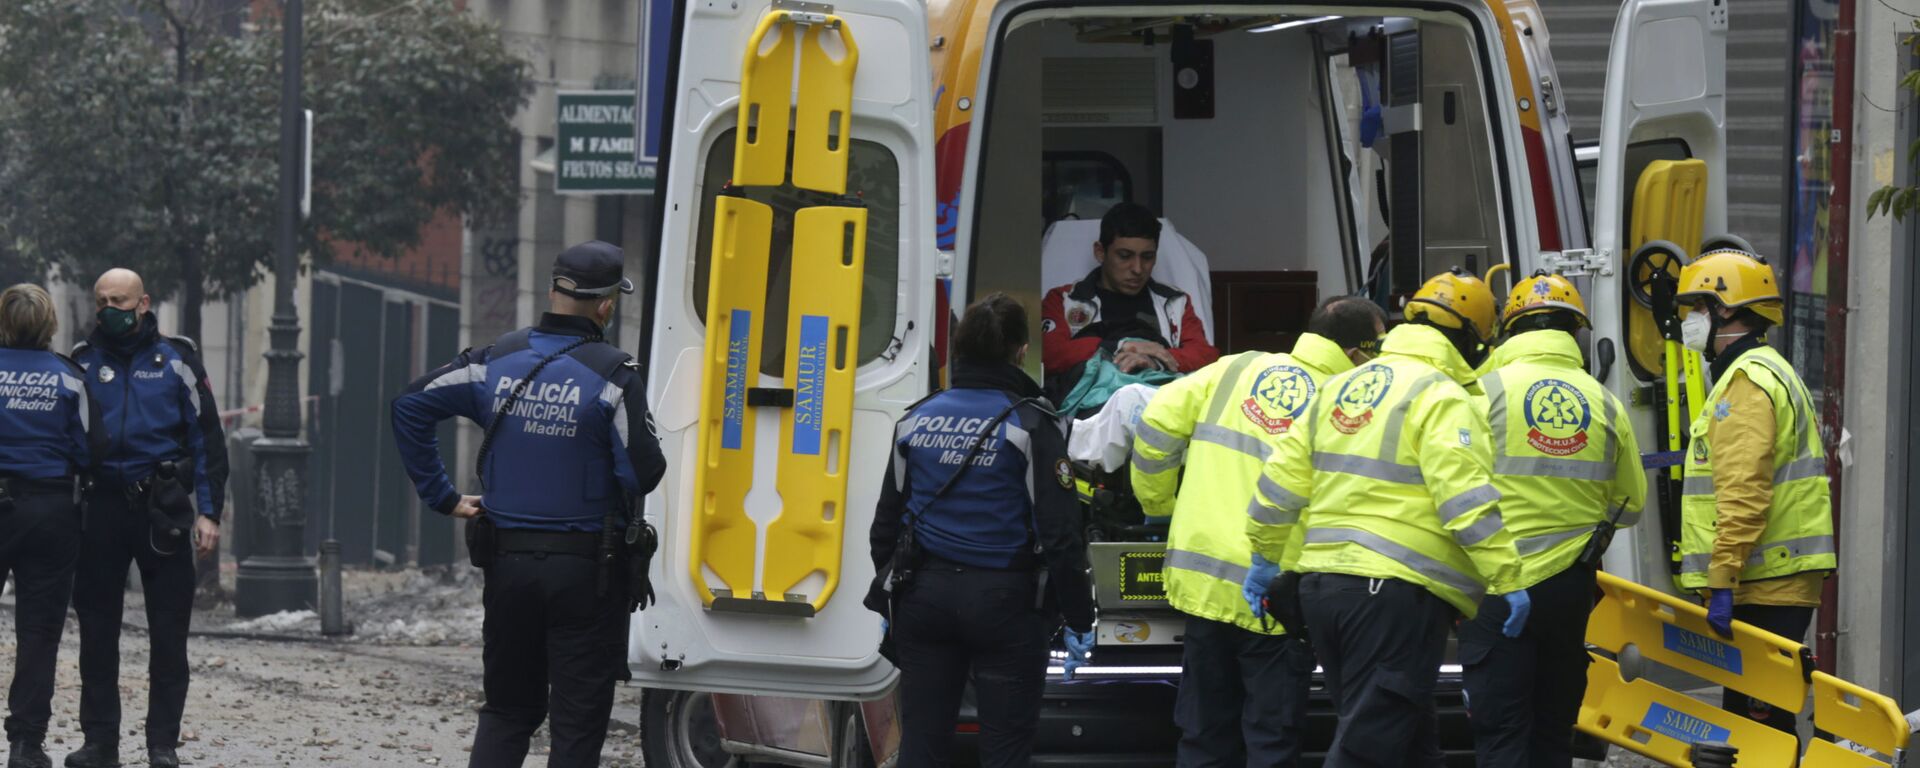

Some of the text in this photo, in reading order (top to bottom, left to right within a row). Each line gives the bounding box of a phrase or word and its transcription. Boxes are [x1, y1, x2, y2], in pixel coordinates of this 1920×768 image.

[570, 137, 584, 153] M
[562, 160, 656, 179] FRUTOS SECOS
[725, 340, 740, 419] SAMUR
[795, 346, 817, 425] SAMUR
[0, 385, 59, 400] NICIPAL
[494, 376, 581, 405] POLICÍA
[5, 398, 57, 411] Madrid
[492, 396, 577, 424] MUNICIPAL
[523, 420, 577, 437] Madrid
[909, 433, 998, 452] MUNICIPAL
[939, 450, 997, 467] Marid
[1137, 572, 1165, 582] ANTES
[1680, 631, 1725, 659] SAMUR
[1663, 710, 1712, 740] SAMUR
